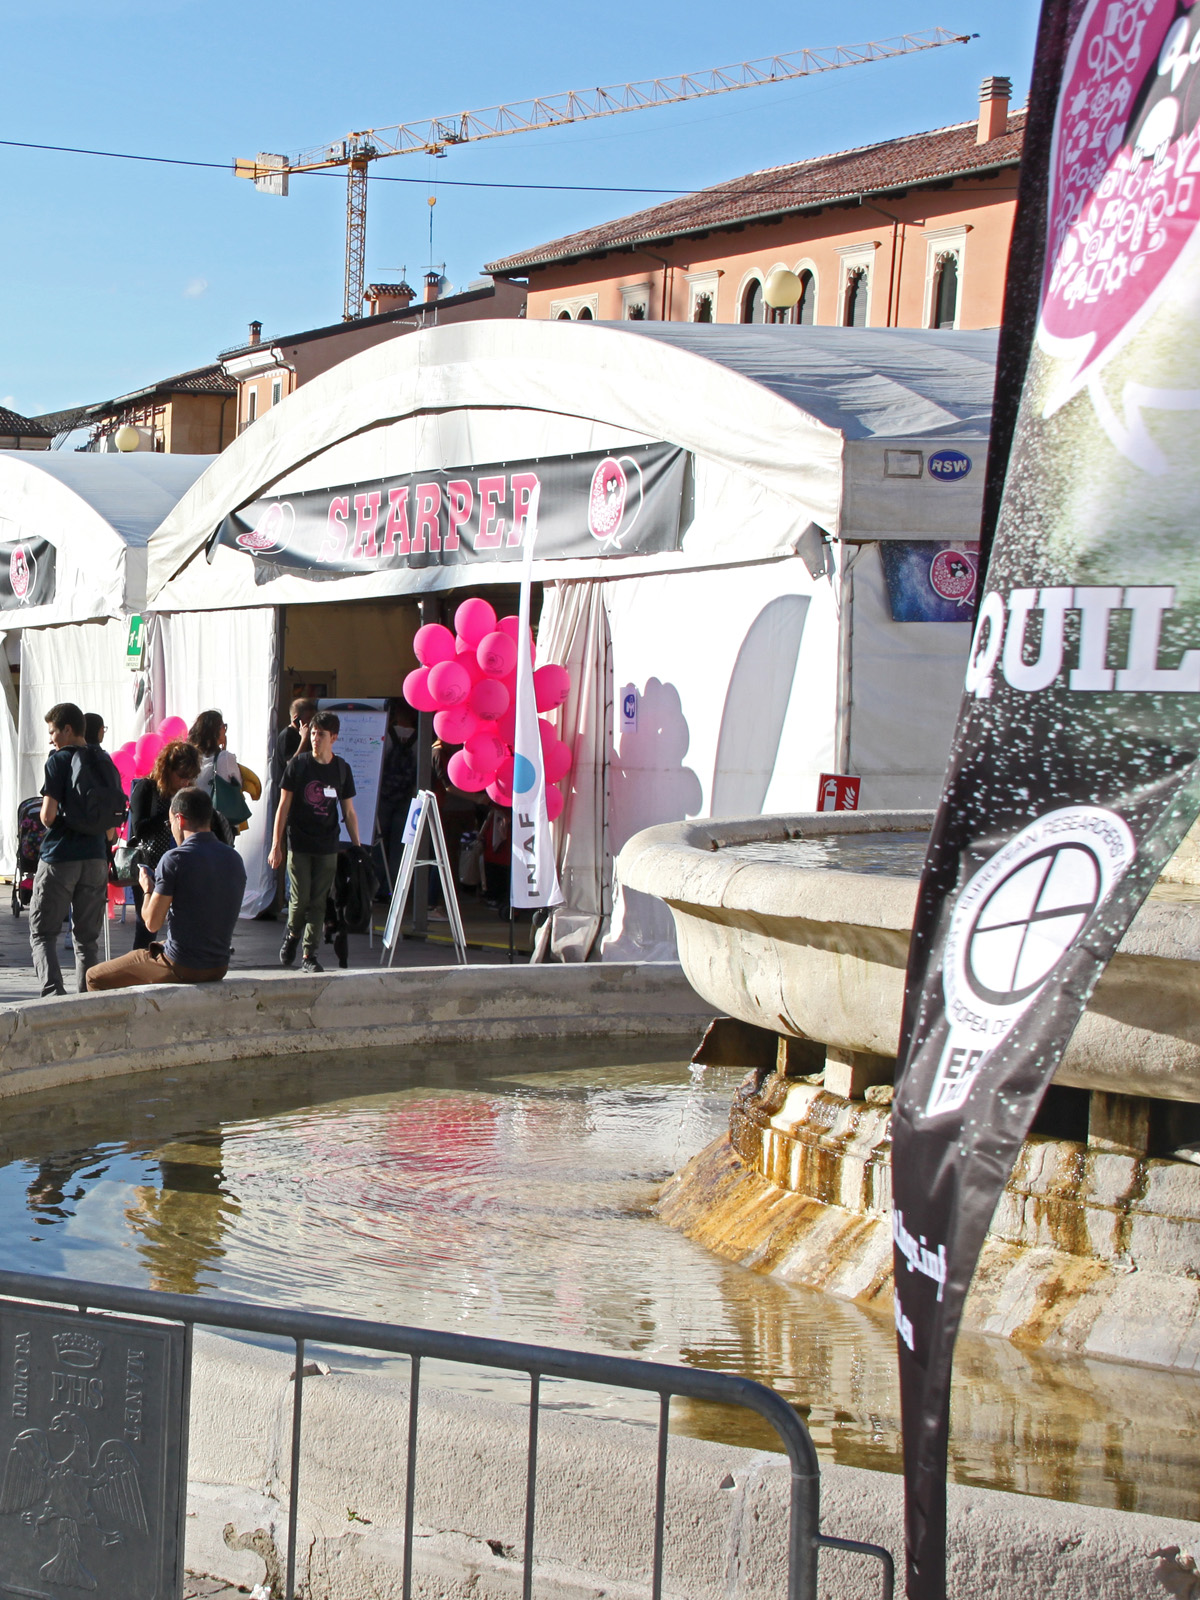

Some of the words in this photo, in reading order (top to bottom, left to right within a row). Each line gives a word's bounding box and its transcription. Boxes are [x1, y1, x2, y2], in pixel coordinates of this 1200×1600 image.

[931, 459, 968, 473] RSW
[316, 472, 541, 562] SHARPER
[518, 813, 540, 897] INAF
[51, 1371, 104, 1410] PHS
[124, 1348, 145, 1441] MANET
